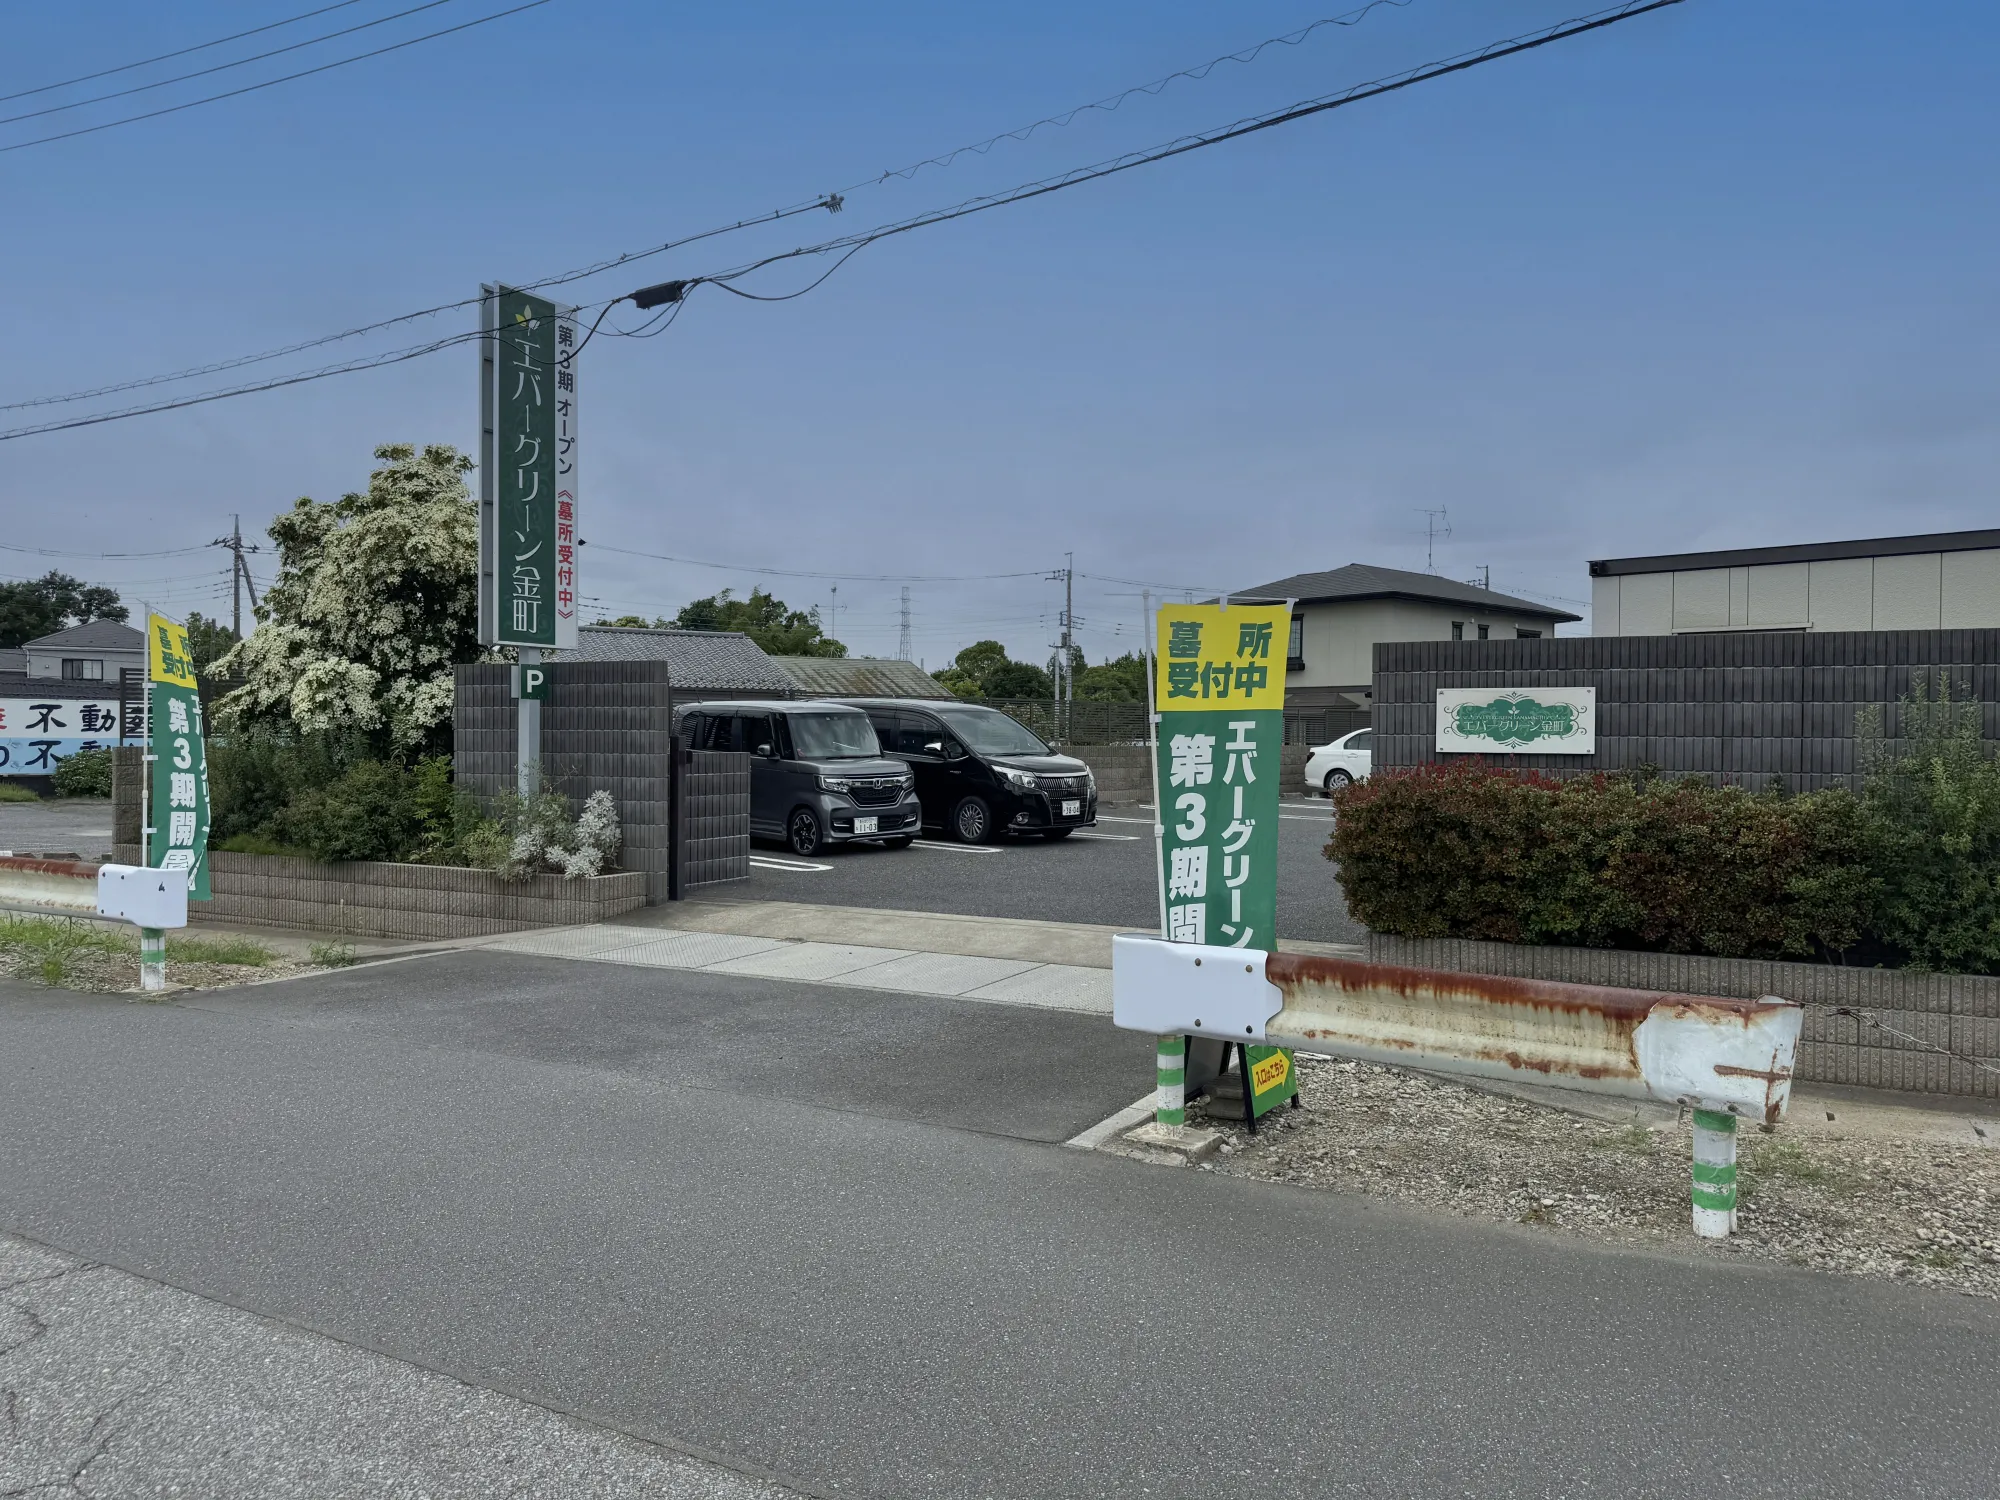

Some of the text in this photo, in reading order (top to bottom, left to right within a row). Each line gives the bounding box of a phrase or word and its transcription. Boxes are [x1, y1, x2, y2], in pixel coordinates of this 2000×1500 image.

[511, 337, 543, 634] エバーグリーン金町
[526, 669, 544, 693] P
[1167, 661, 1268, 699] 受付中
[1463, 720, 1565, 732] エバーグリーン金町
[1220, 721, 1257, 948] エバーグリーン
[1255, 1059, 1285, 1088] 入口はこちら
